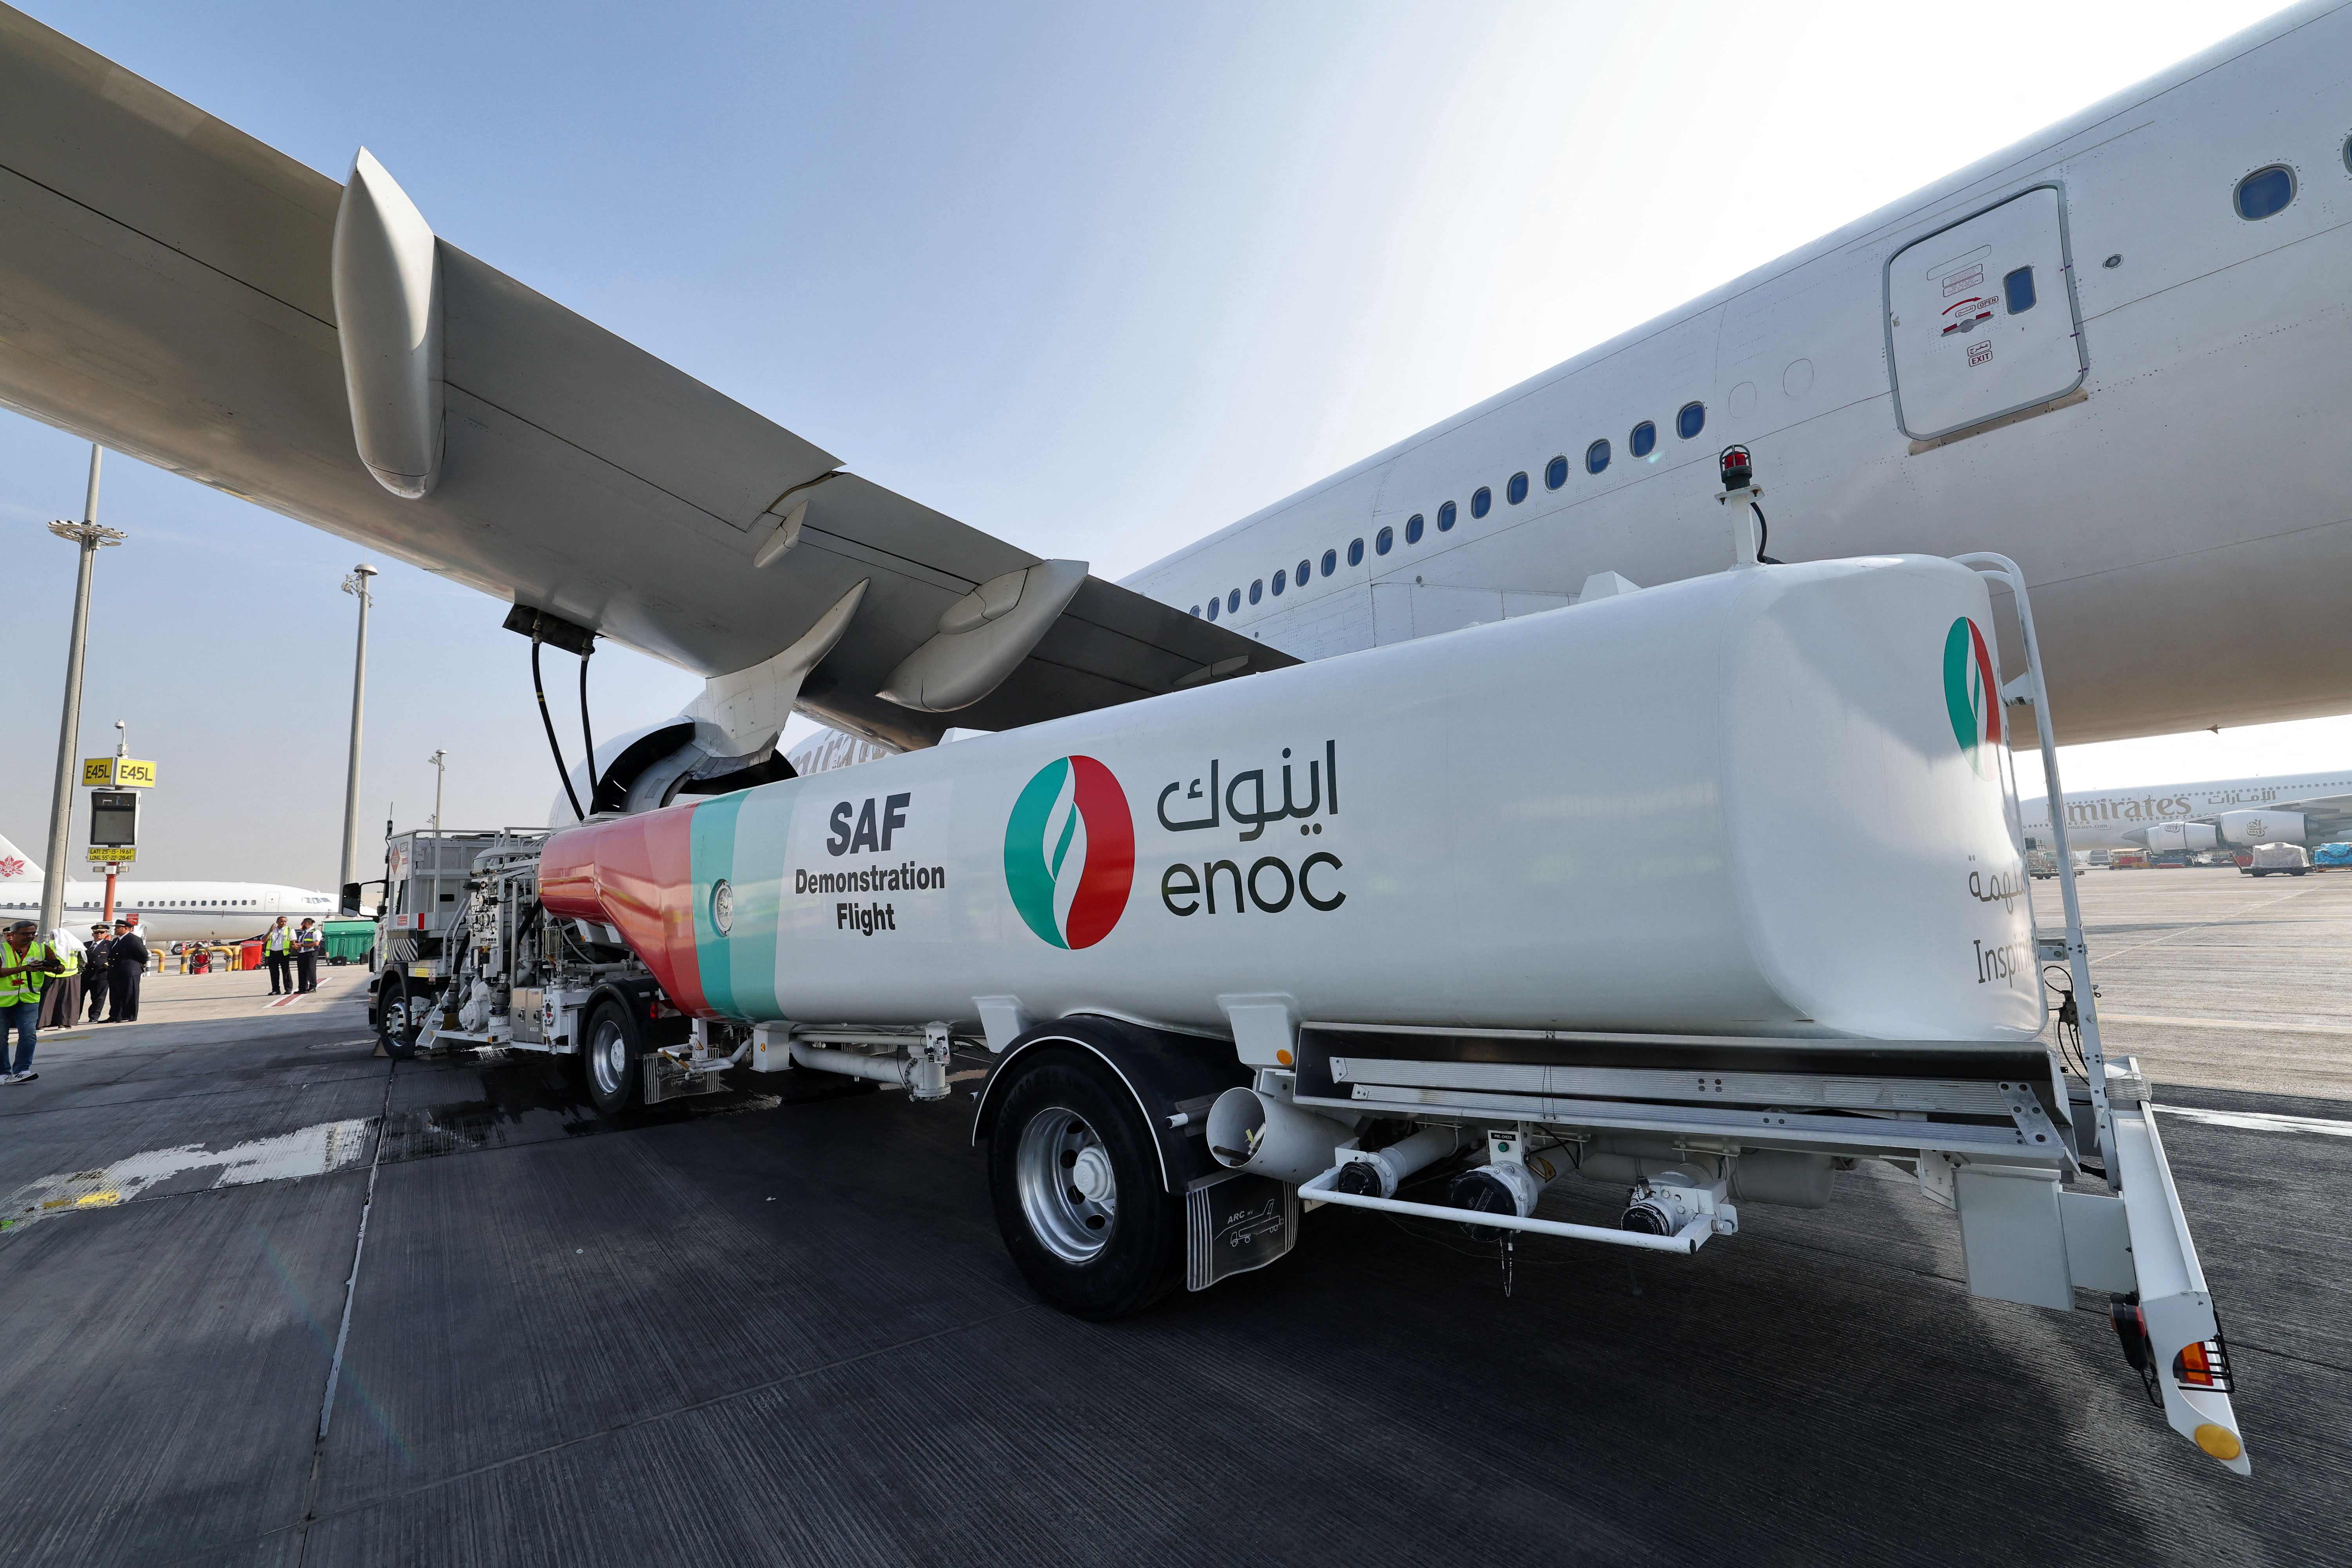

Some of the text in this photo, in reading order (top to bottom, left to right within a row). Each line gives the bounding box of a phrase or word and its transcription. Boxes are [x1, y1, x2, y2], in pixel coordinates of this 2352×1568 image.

[1980, 298, 1996, 307] OPEN
[1972, 353, 1989, 365] EXIT
[86, 764, 110, 779] E45L
[120, 765, 152, 781] E45L
[827, 792, 911, 857] SAF
[795, 861, 945, 894] Demonstration
[1161, 852, 1347, 916] enoc
[837, 902, 896, 936] Flight
[1227, 1211, 1245, 1224] ARC
